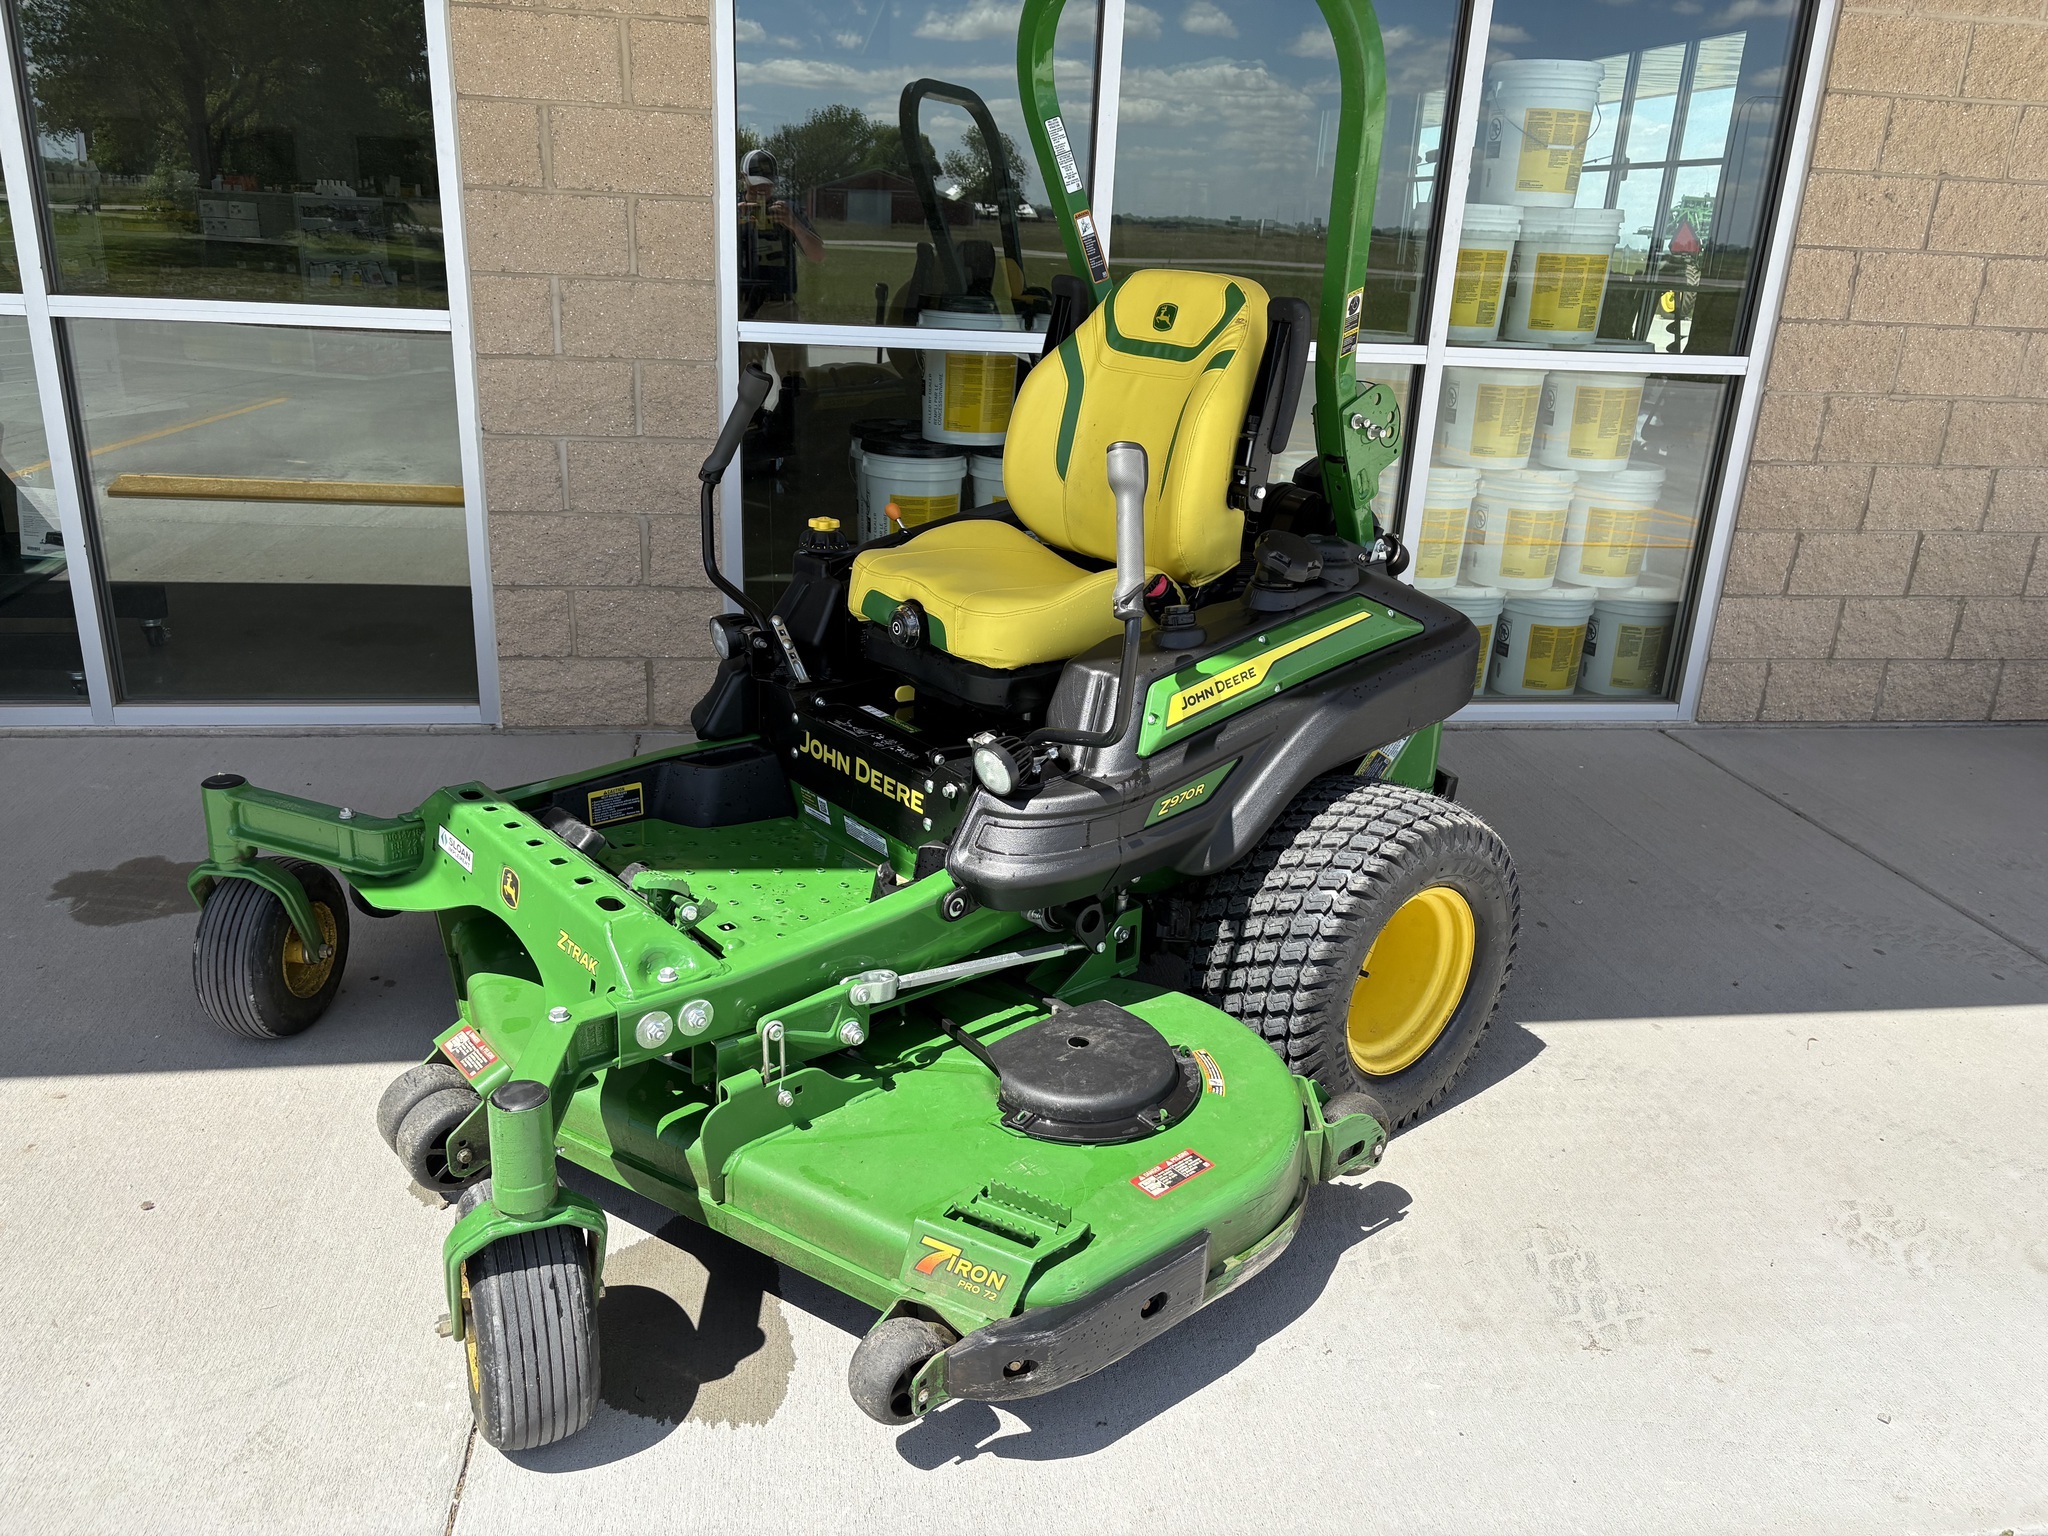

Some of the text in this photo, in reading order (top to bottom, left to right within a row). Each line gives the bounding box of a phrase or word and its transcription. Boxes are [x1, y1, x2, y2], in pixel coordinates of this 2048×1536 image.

[1181, 667, 1256, 710] JOHN DEERE
[800, 730, 850, 776] JOHN
[855, 756, 925, 815] DEERE
[1157, 783, 1205, 817] Z970R
[447, 846, 471, 868] IMPLEMENT
[448, 837, 471, 862] SLOAN
[557, 928, 599, 977] ZTRAK
[957, 1279, 998, 1302] PRO 72
